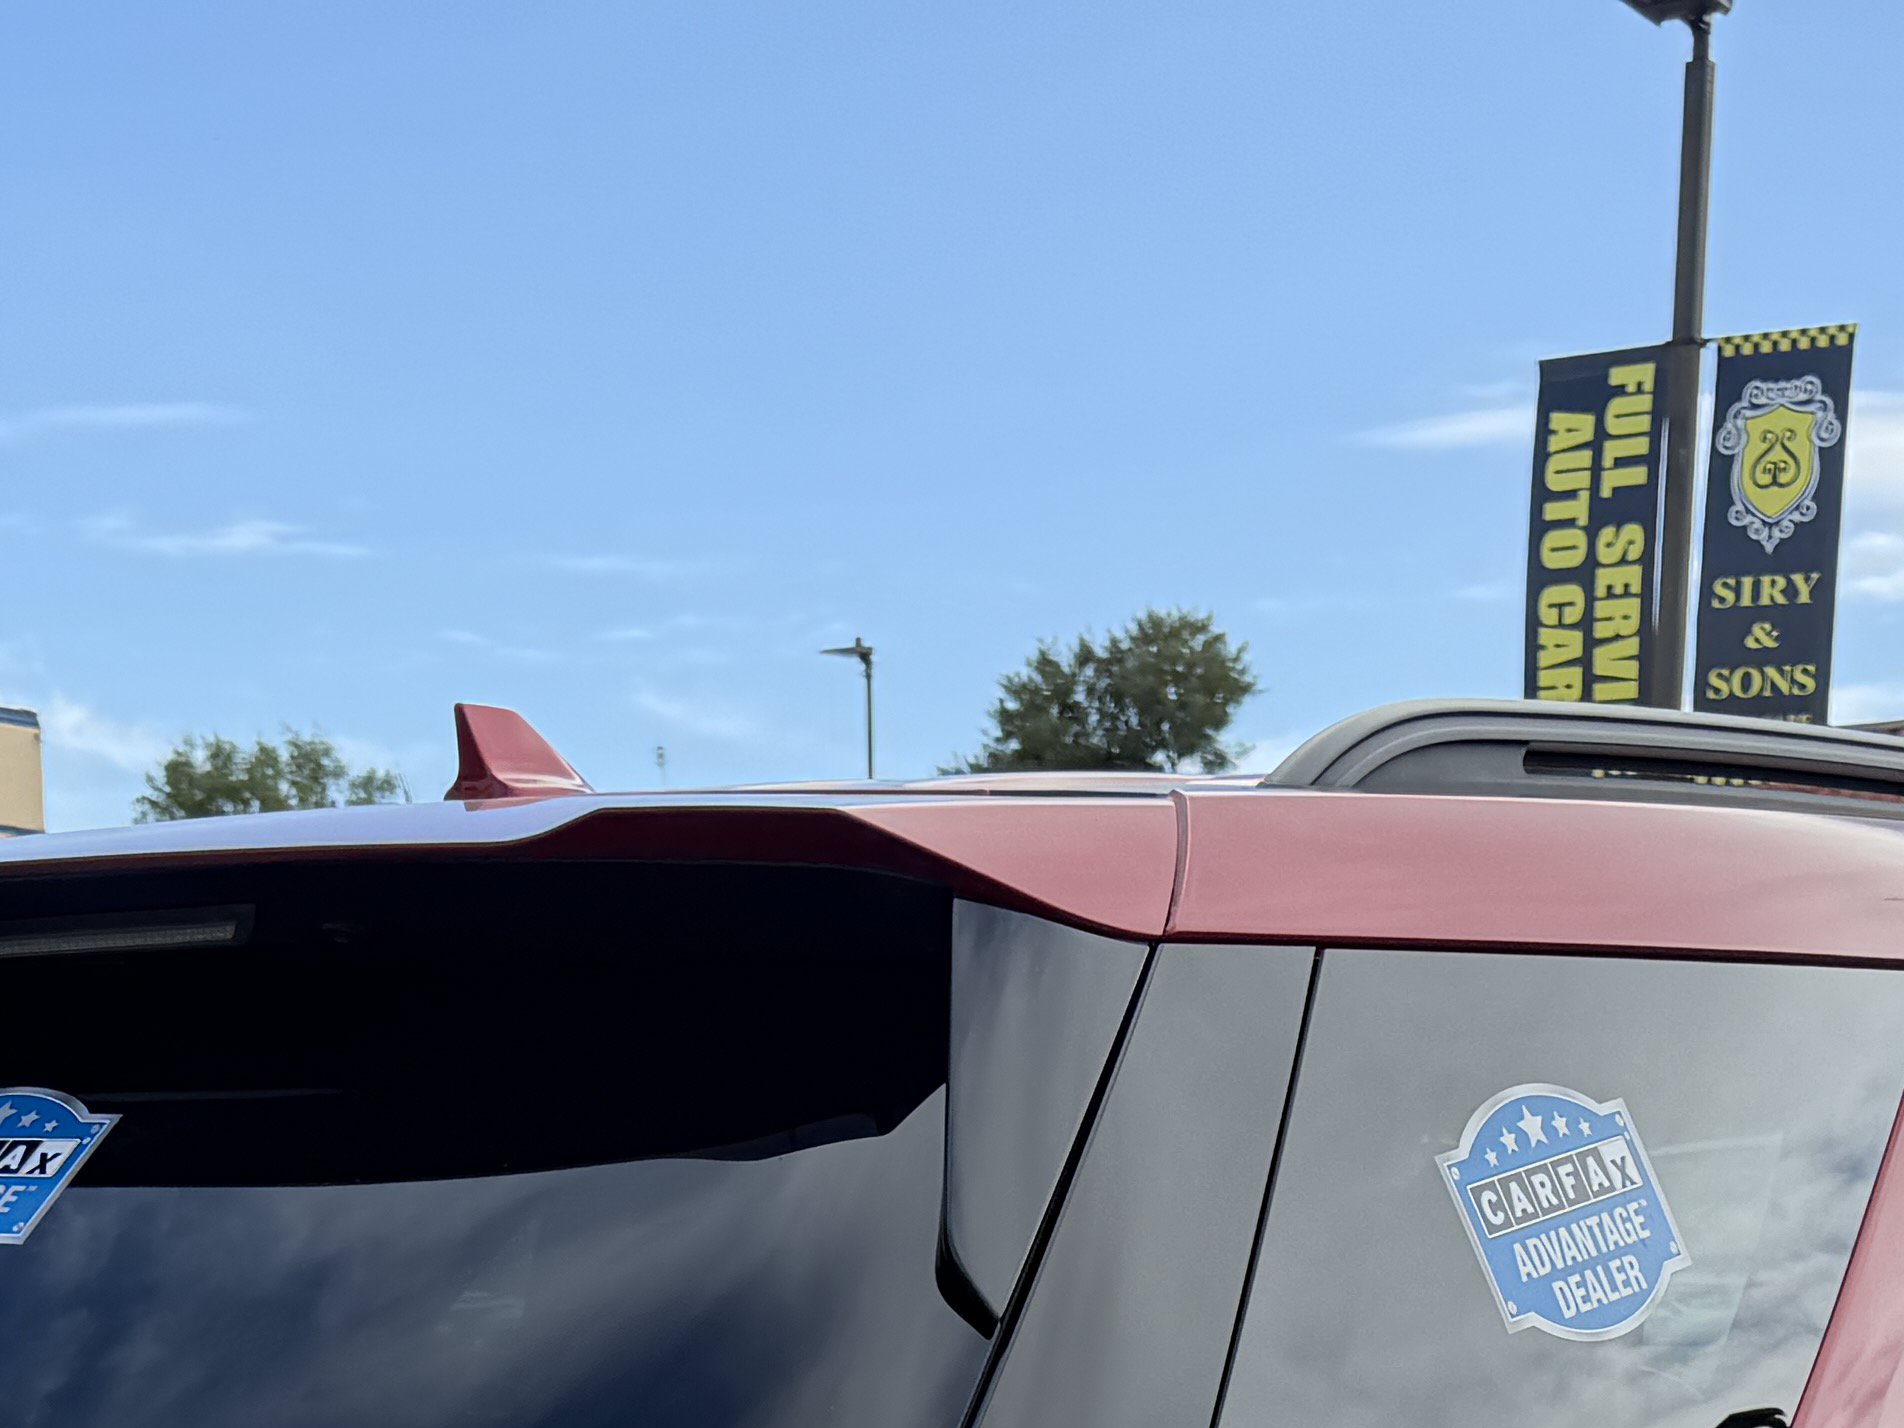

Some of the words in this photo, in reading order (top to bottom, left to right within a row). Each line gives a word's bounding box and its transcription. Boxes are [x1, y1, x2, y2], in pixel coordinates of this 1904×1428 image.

[1600, 361, 1656, 498] FULL
[1539, 412, 1595, 570] AUTO
[1711, 571, 1822, 610] SIRY
[1743, 620, 1781, 650] &
[1706, 663, 1817, 700] SONS
[1479, 1154, 1640, 1226] CARFAX
[1552, 1254, 1648, 1319] DEALER
